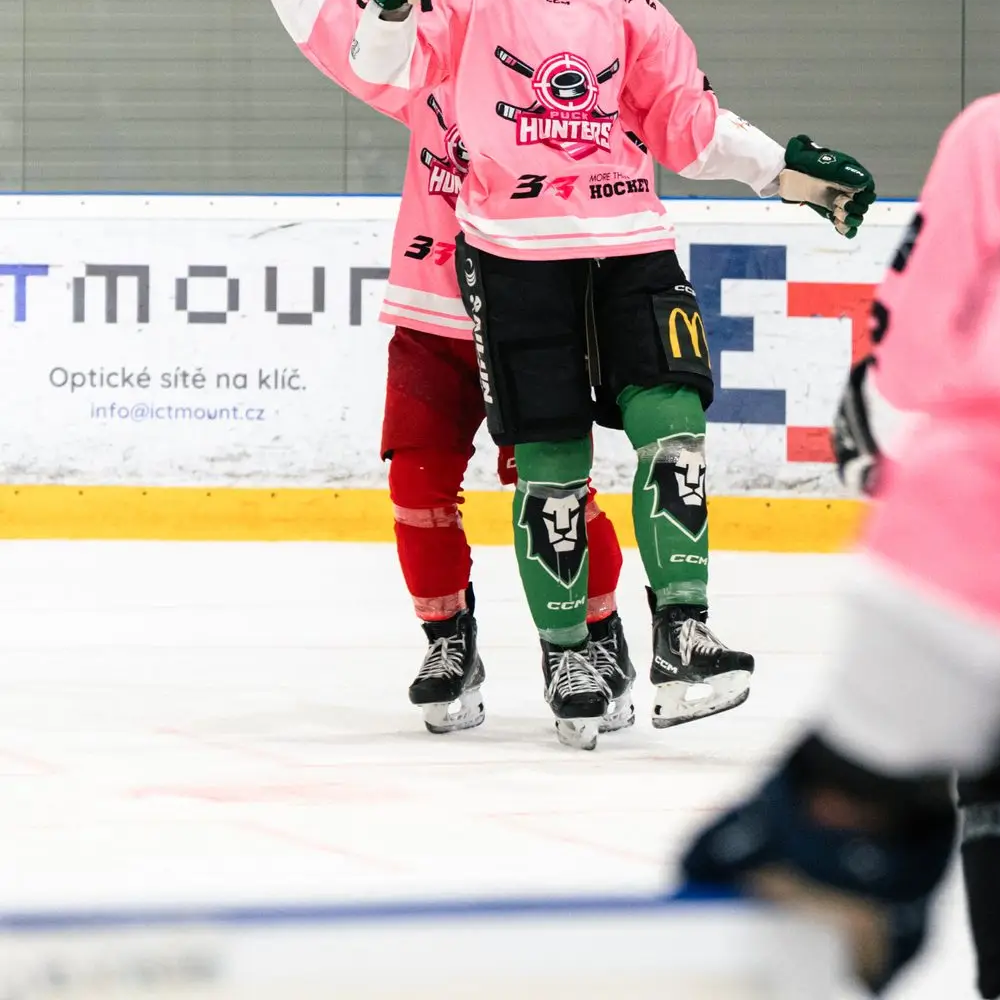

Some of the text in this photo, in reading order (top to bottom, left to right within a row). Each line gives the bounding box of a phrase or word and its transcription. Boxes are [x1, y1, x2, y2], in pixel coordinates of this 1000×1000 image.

[550, 111, 589, 120] PUCK
[520, 117, 613, 150] HUNTERS
[429, 165, 462, 194] HUN
[589, 172, 611, 182] MORE
[589, 178, 650, 200] HOCKEY
[49, 366, 307, 393] Optické sítě na klíč.
[90, 402, 266, 422] info@ictmount.cz
[670, 553, 708, 566] CCM
[547, 596, 586, 611] CCM
[654, 655, 679, 674] CCM
